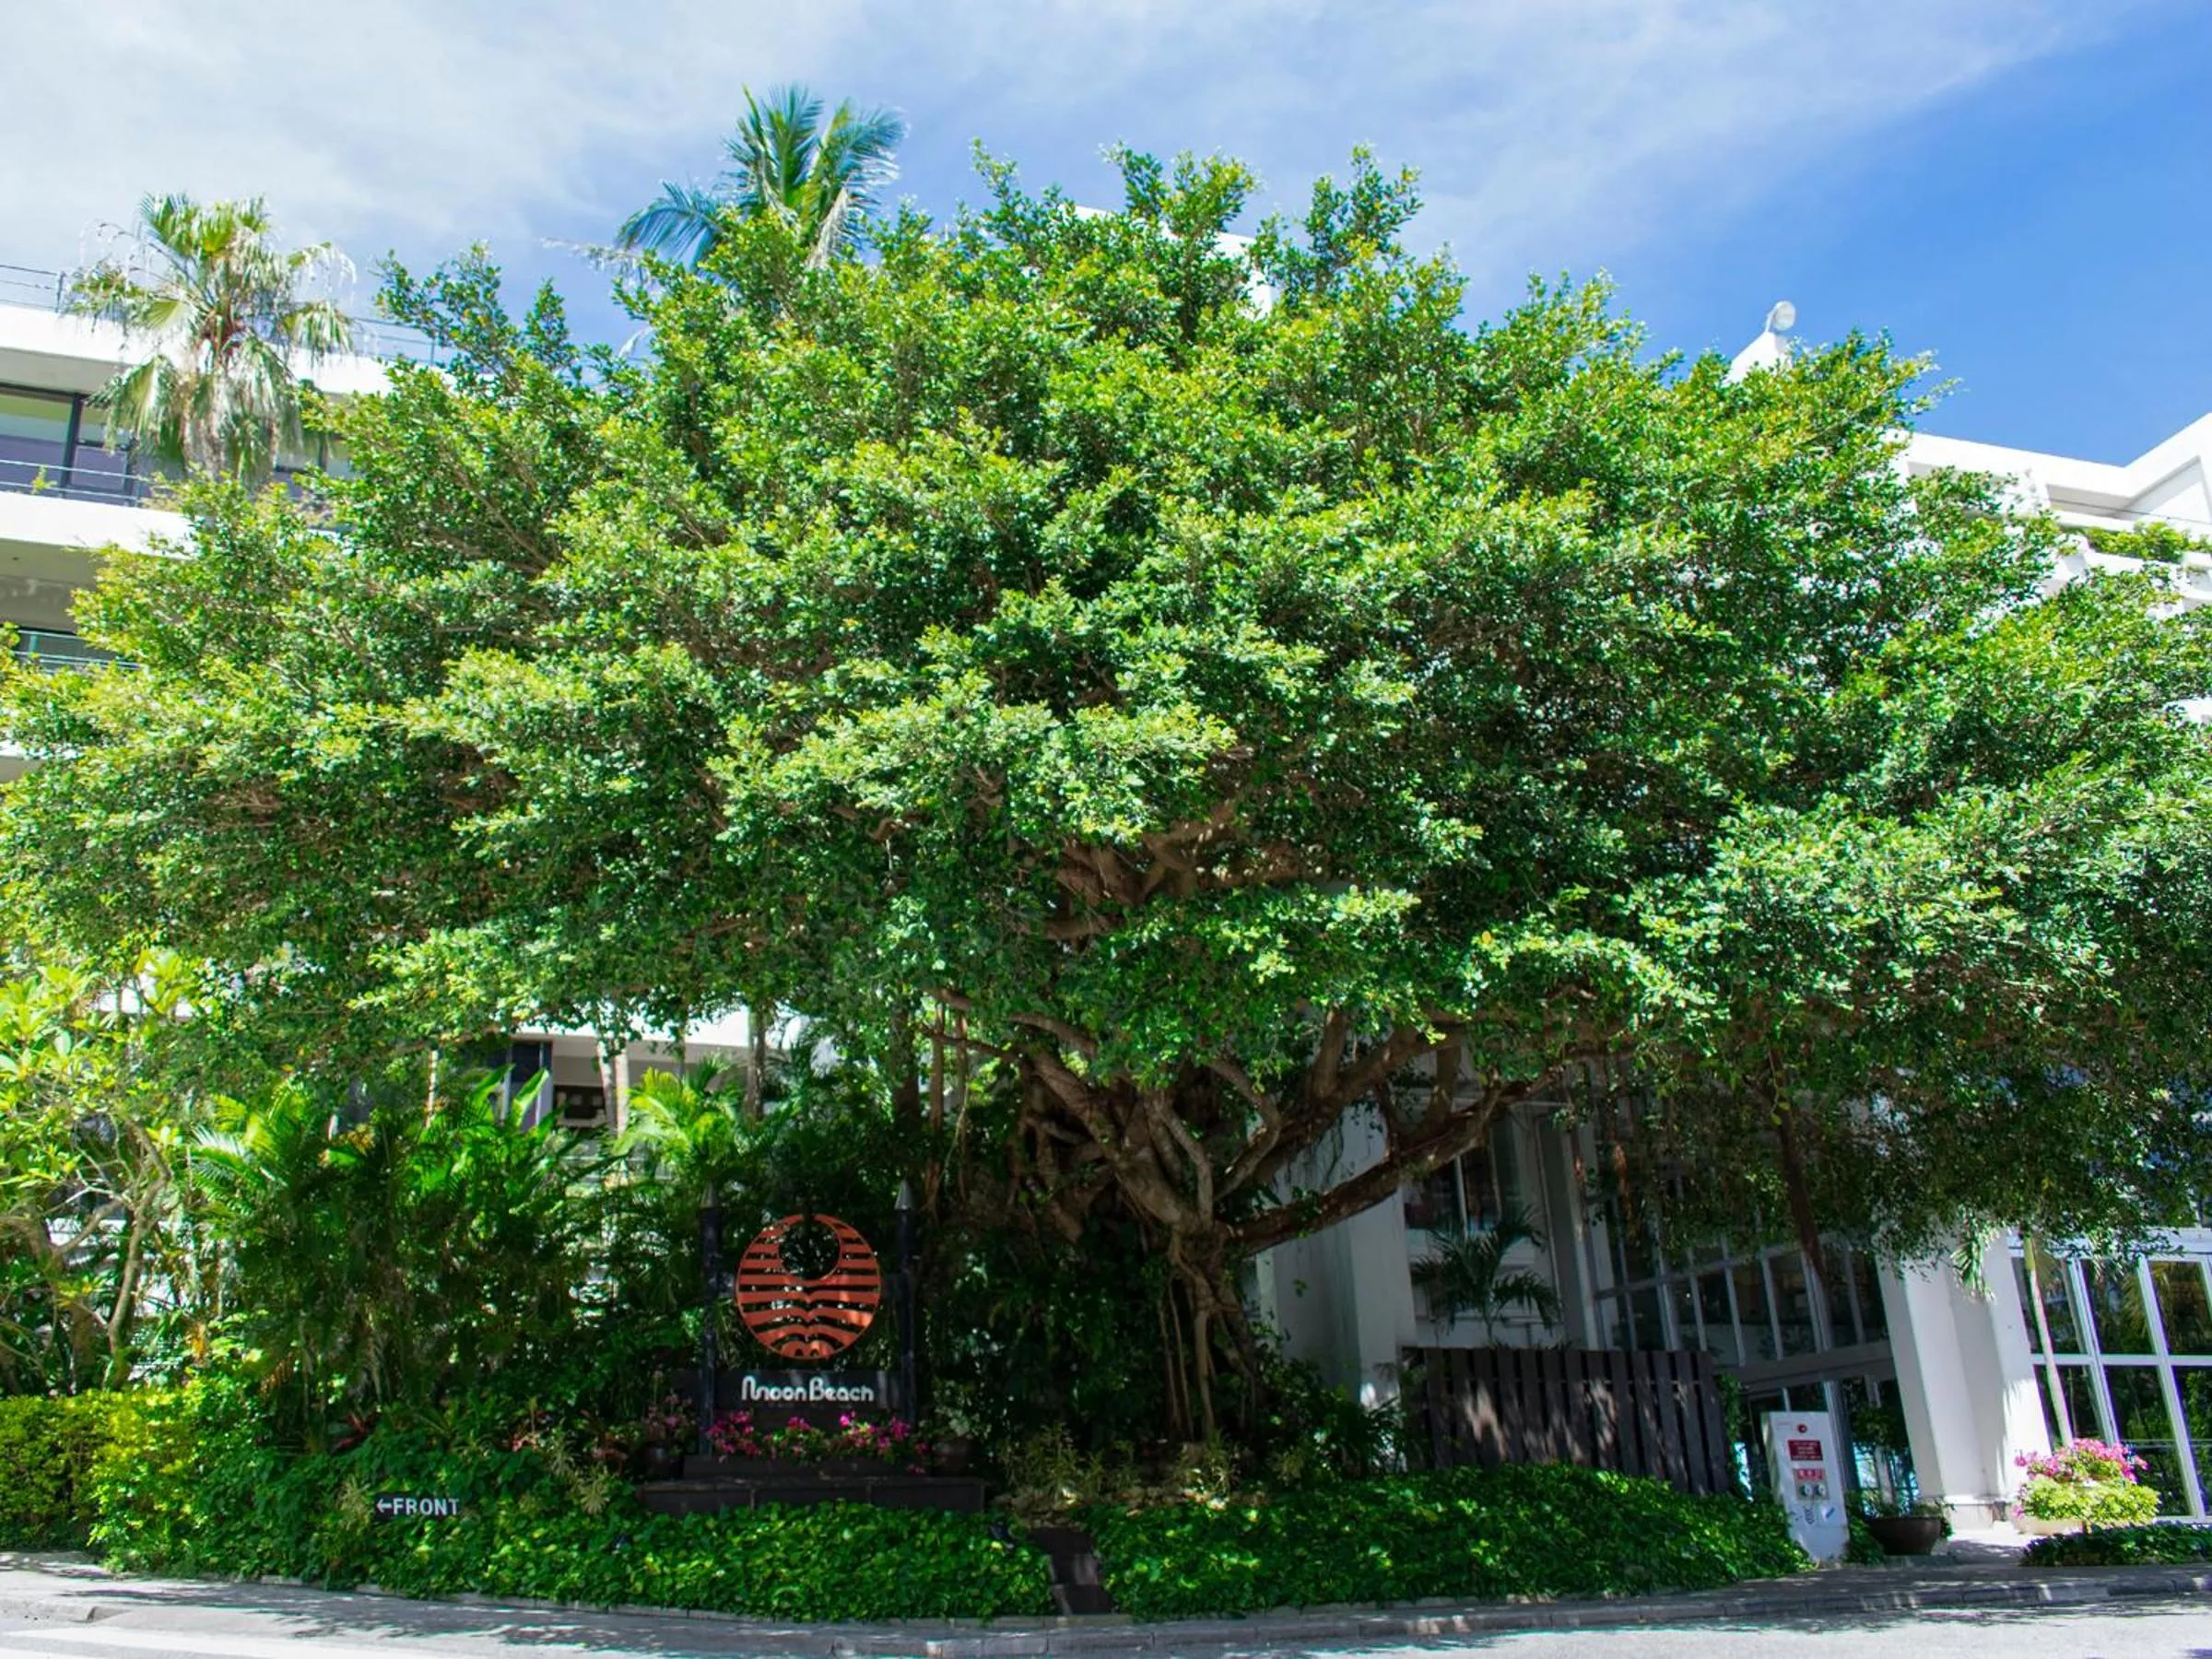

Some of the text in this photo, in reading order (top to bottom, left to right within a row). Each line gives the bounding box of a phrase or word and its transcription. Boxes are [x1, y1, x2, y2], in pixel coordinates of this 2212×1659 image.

[741, 1374, 875, 1402] Moon Beach
[393, 1497, 460, 1516] FRONT
